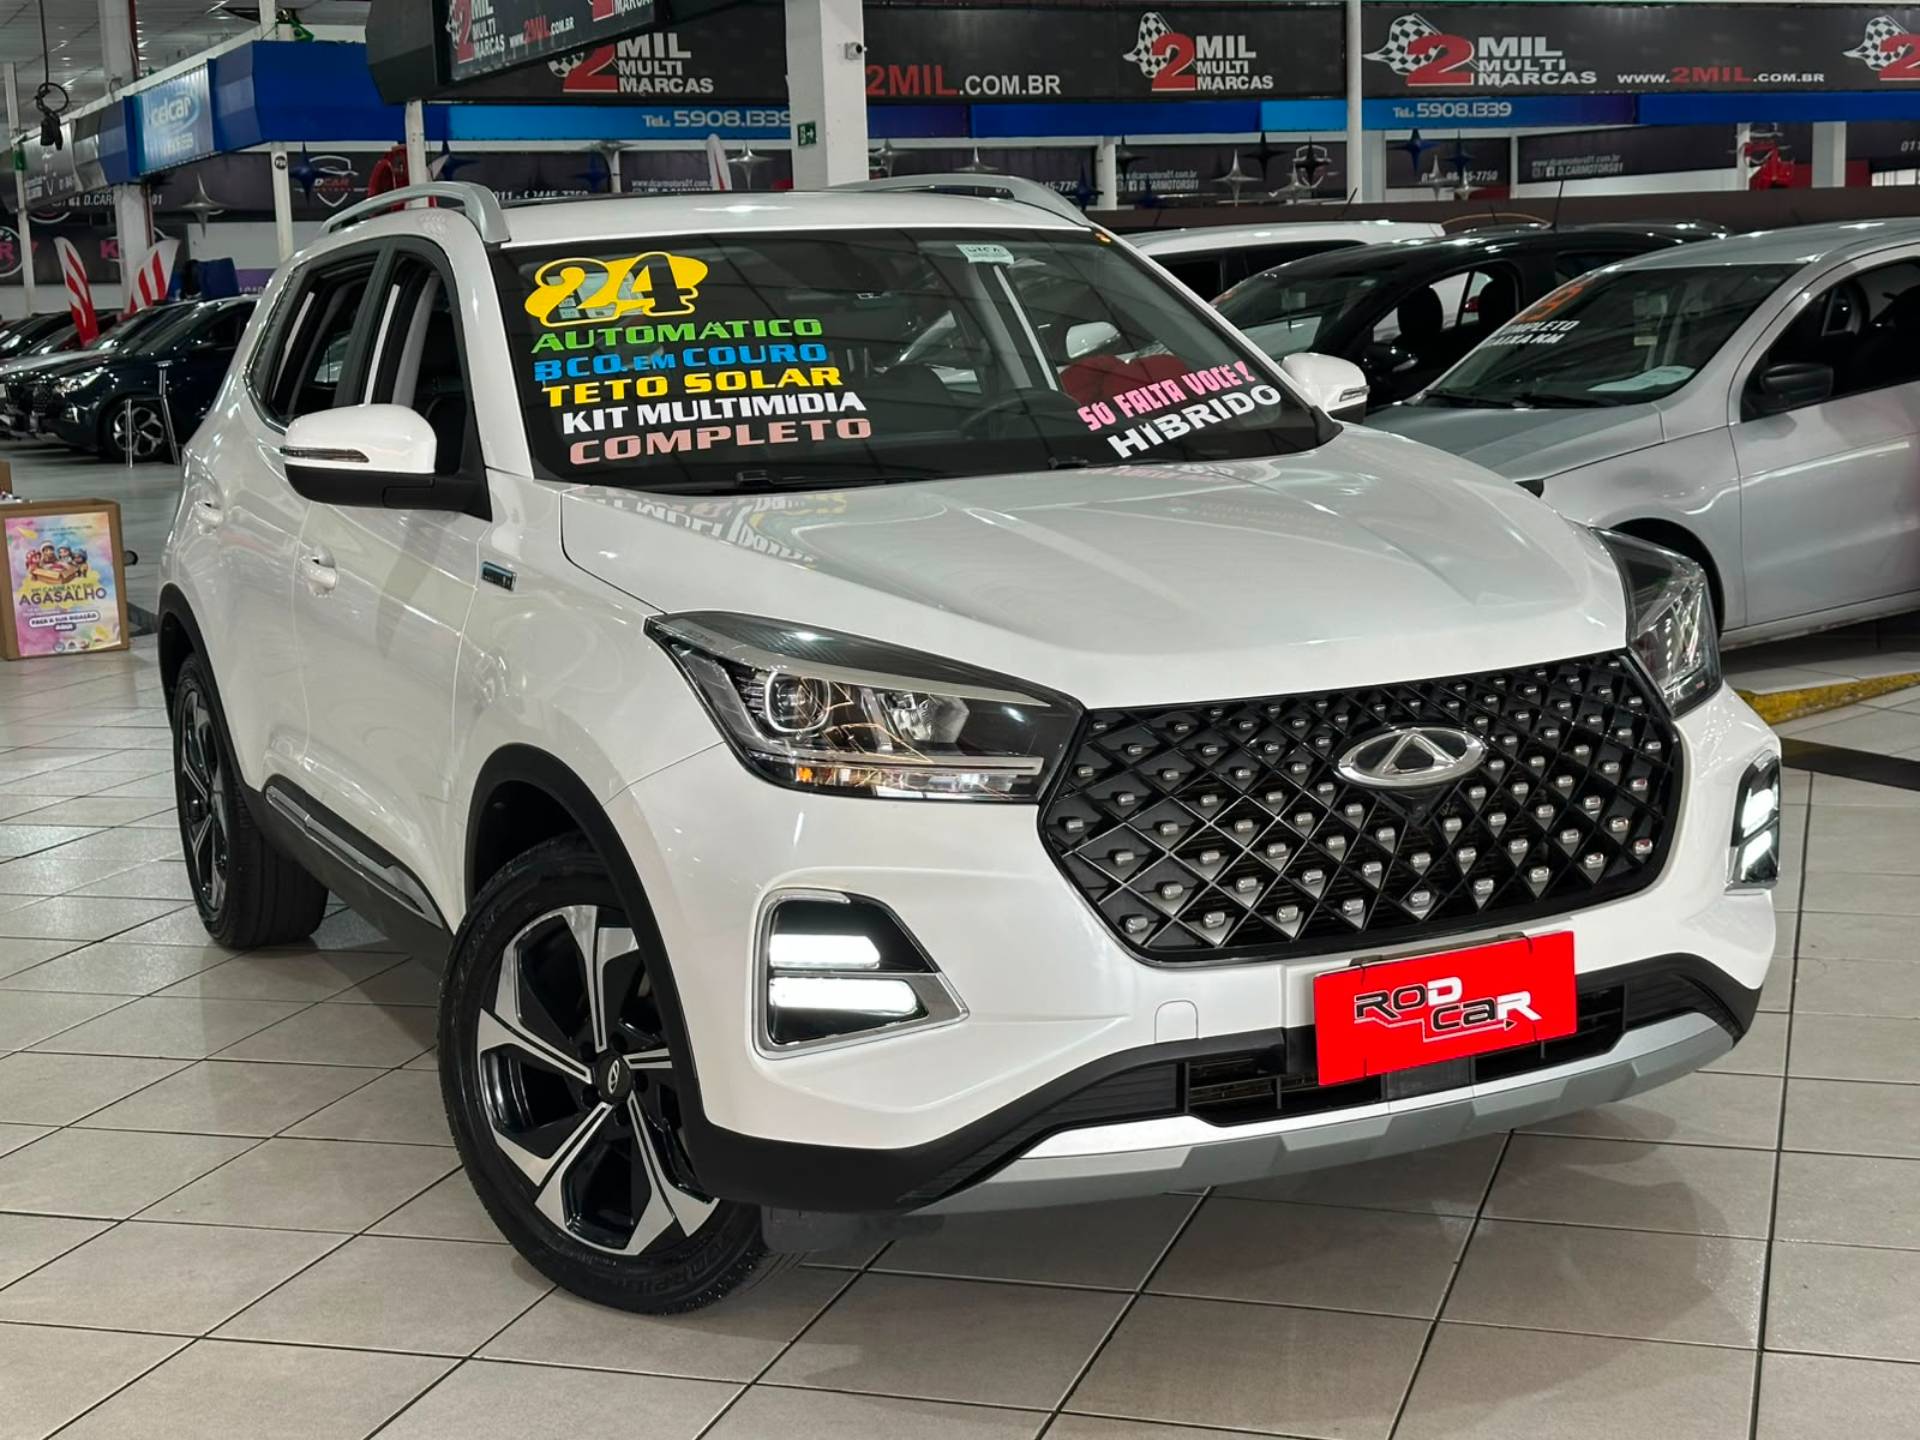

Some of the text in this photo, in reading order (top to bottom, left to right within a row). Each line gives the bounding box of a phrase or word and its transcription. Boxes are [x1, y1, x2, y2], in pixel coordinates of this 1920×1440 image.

[472, 18, 496, 40] MULTI
[474, 34, 505, 59] MARCAS
[562, 33, 691, 93] 2 MIL
[618, 60, 682, 76] MULTI
[1152, 33, 1257, 91] 2 MIL
[1197, 60, 1249, 74] MULTI
[1407, 34, 1563, 86] 2 MIL
[1479, 59, 1566, 72] MULTI
[619, 77, 714, 94] MARCAS
[865, 64, 1062, 96] 2MIL.COM.BR
[1197, 75, 1273, 90] MARCAS
[1479, 71, 1597, 86] MARCAS
[1416, 102, 1512, 118] 5908.1339
[527, 251, 707, 327] 24
[632, 353, 676, 371] EM
[683, 343, 828, 369] COURO
[541, 366, 844, 407] TETO SOLAR
[1112, 379, 1188, 418] FALTA
[562, 406, 629, 434] KIT
[569, 418, 872, 465] COMPLETO
[19, 587, 107, 606] AGASALHO
